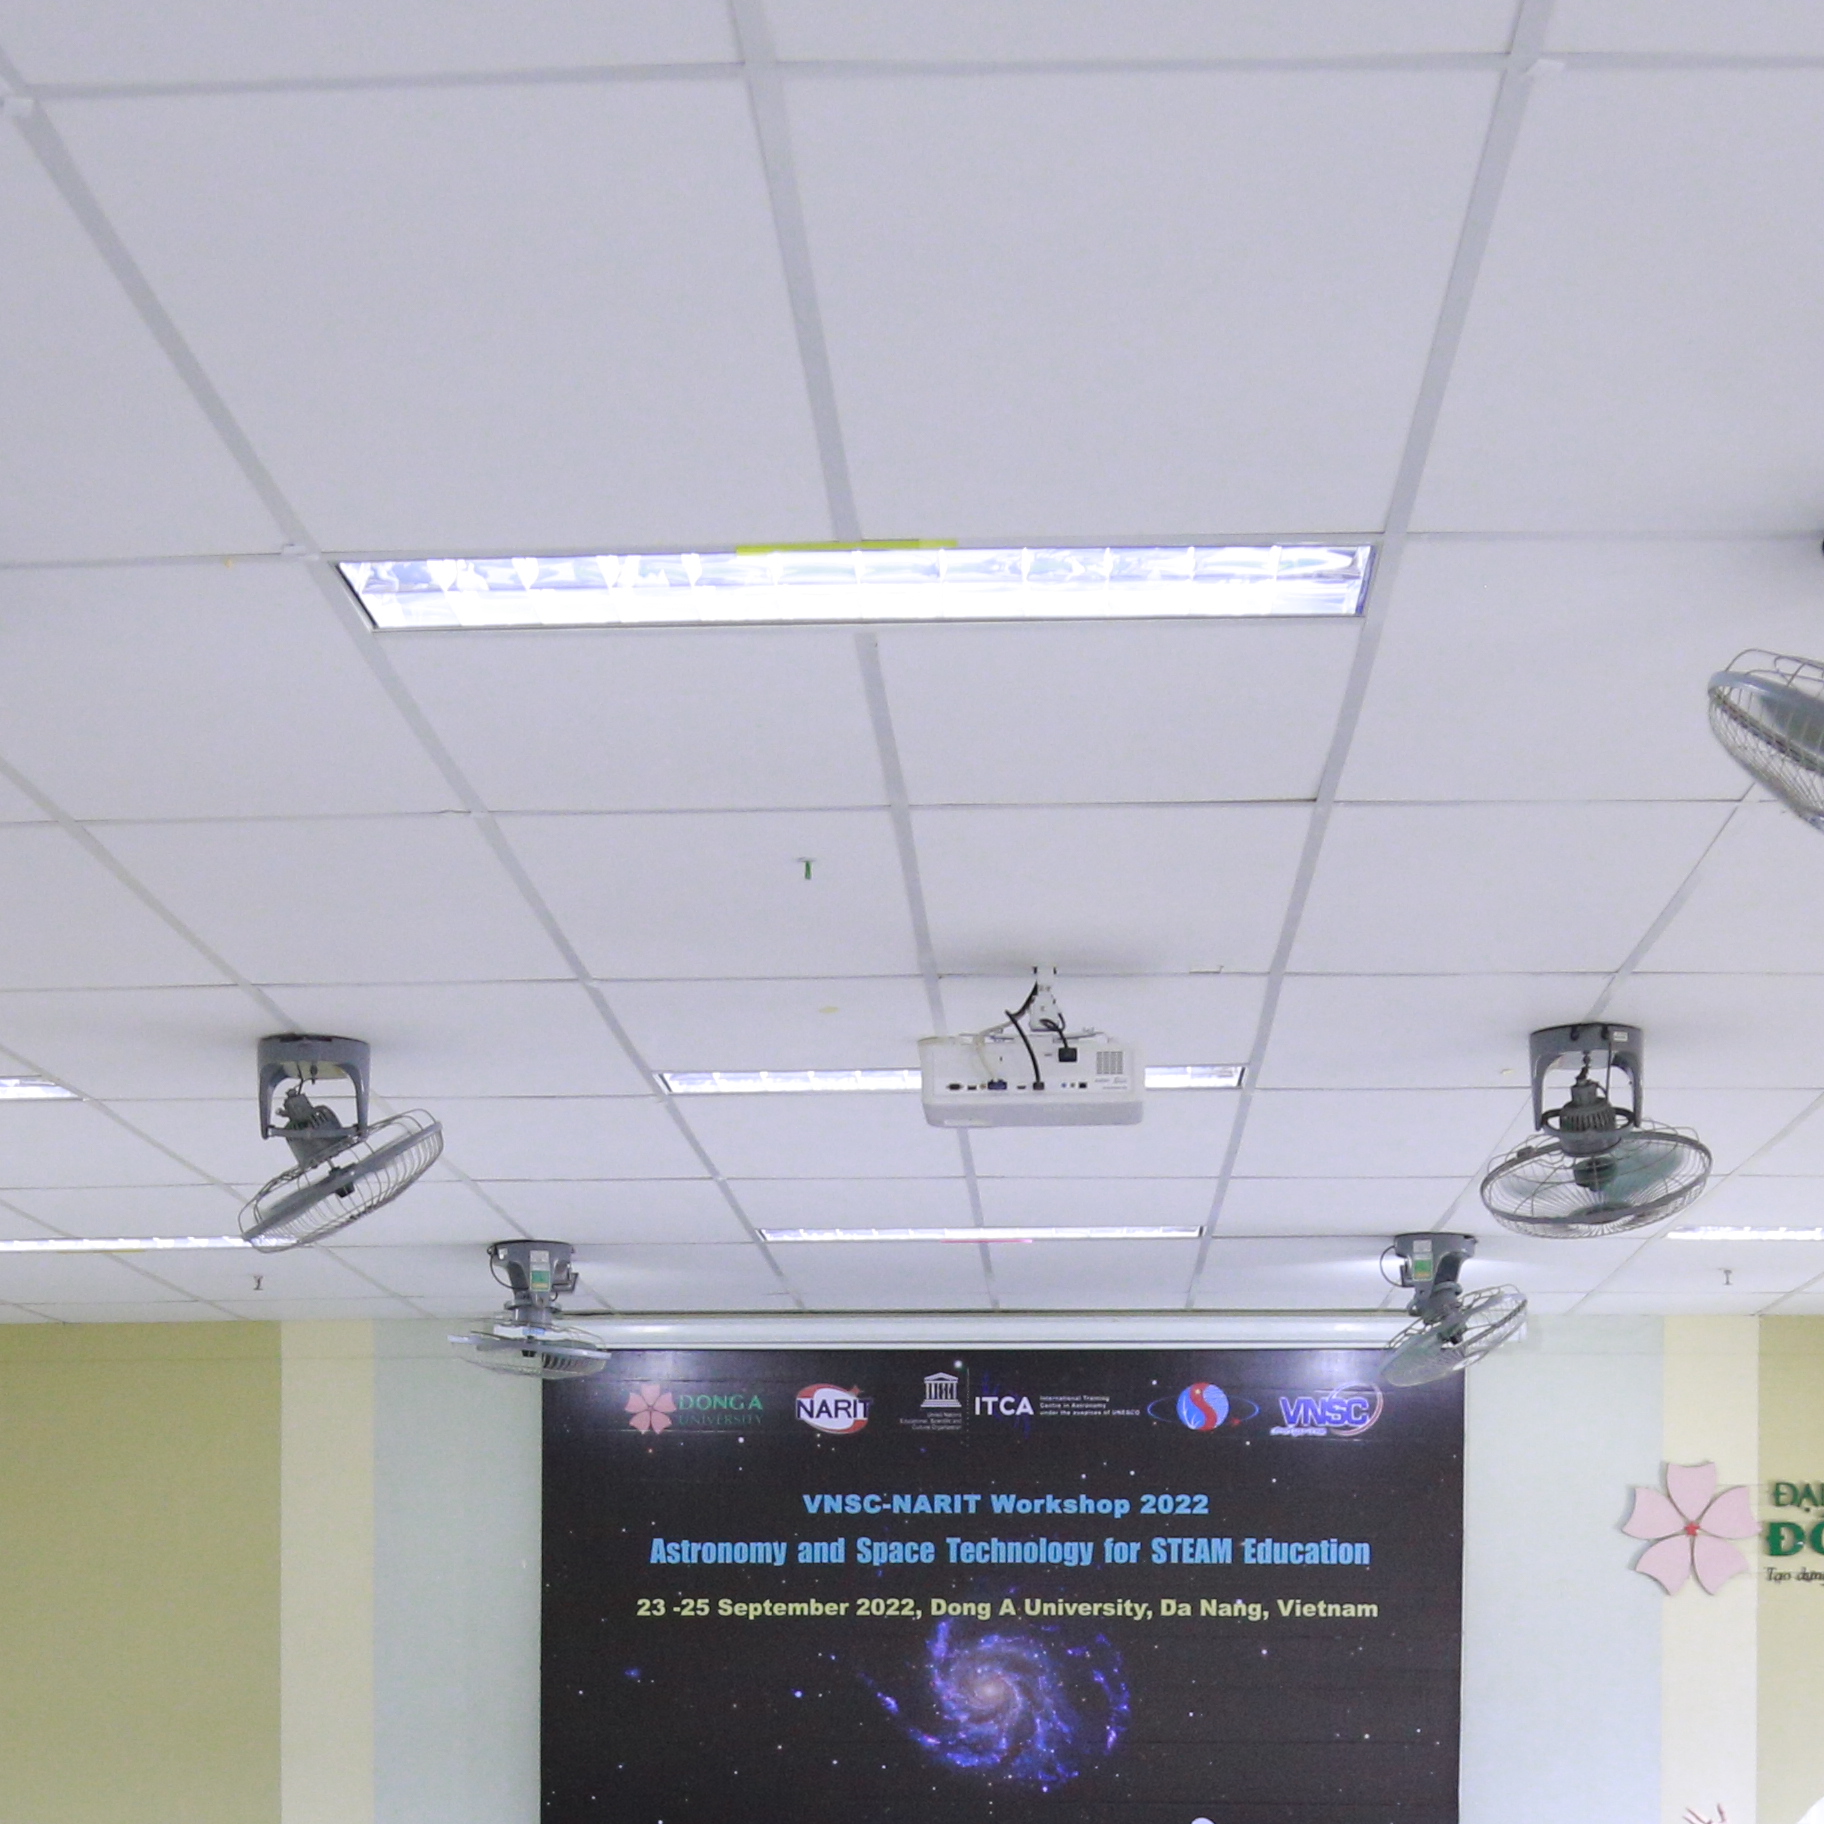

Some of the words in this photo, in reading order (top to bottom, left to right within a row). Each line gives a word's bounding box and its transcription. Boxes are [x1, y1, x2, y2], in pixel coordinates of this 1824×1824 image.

[796, 1398, 872, 1419] NARIT
[975, 1396, 1034, 1416] ITCA
[1278, 1396, 1370, 1427] VNSC
[802, 1494, 981, 1514] VNSC-NARIT
[990, 1494, 1131, 1519] Workshop
[1140, 1494, 1210, 1514] 2022
[650, 1537, 787, 1566] Astronomy
[797, 1537, 845, 1564] and
[856, 1537, 936, 1566] Space
[946, 1537, 1094, 1567] Technology
[1103, 1537, 1142, 1564] for
[1151, 1537, 1233, 1564] STEAM
[1243, 1538, 1371, 1565] Education
[636, 1598, 666, 1616] 23
[673, 1598, 710, 1616] -25
[718, 1598, 849, 1620] September
[856, 1598, 922, 1620] 2022,
[931, 1598, 992, 1620] Dong
[998, 1598, 1017, 1616] A
[1024, 1598, 1153, 1620] University,
[1160, 1599, 1192, 1617] Da
[1200, 1599, 1270, 1621] Nang,
[1277, 1599, 1379, 1618] Vietnam
